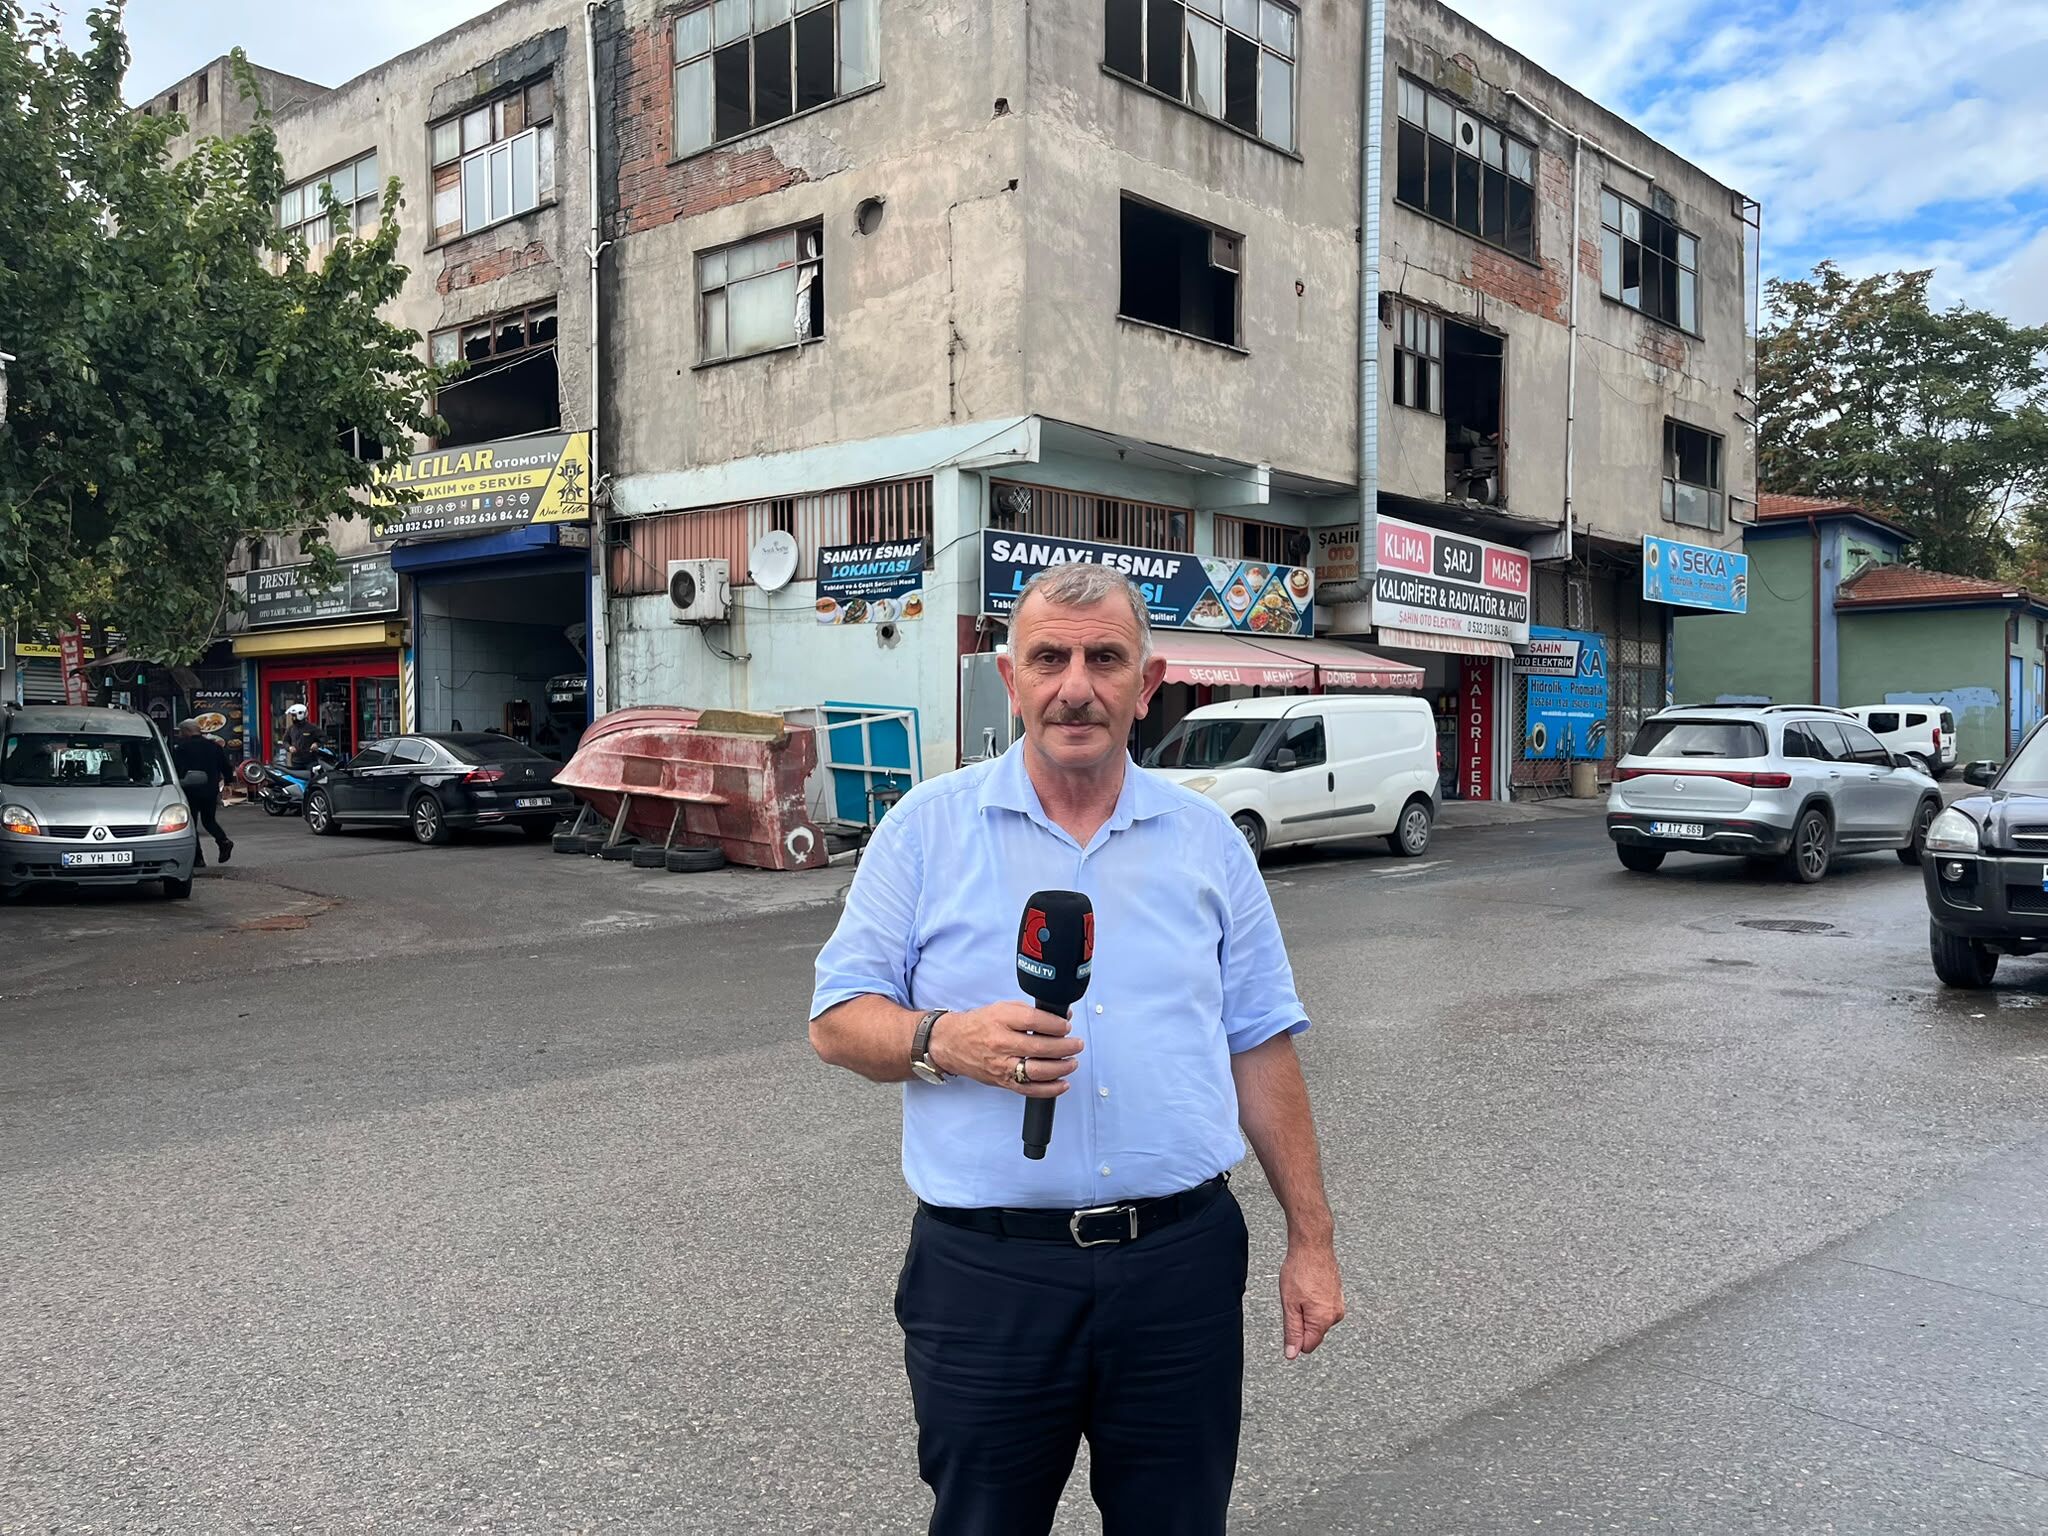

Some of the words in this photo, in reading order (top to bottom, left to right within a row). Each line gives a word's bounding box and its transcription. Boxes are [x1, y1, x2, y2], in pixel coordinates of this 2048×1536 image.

[494, 452, 560, 469] OTOMOTİV
[461, 482, 475, 492] ve
[479, 474, 532, 489] SERVİS
[405, 521, 421, 532] 032
[422, 519, 433, 530] 43
[434, 518, 445, 529] 01
[453, 513, 477, 526] 0532
[479, 512, 497, 523] 636
[500, 510, 515, 521] 84
[516, 508, 529, 520] 42
[875, 543, 921, 559] ESNAF
[1328, 546, 1355, 561] OTO
[1443, 546, 1473, 574] ŞARJ
[832, 560, 911, 578] LOKANTASI
[1101, 552, 1181, 579] ESNAF
[1491, 557, 1522, 587] MARŞ
[1682, 549, 1728, 578] SEKA
[1379, 578, 1437, 607] KALORİFER
[1439, 592, 1446, 607] &
[1449, 591, 1497, 616] RADYATÖR
[1498, 602, 1506, 617] &
[1508, 599, 1526, 620] AKÜ
[1149, 613, 1176, 622] eşitleri
[1420, 613, 1432, 626] OTO
[1472, 621, 1482, 633] 532
[1483, 623, 1494, 635] 313
[1494, 624, 1501, 636] 84
[1501, 625, 1509, 637] 50
[1514, 657, 1530, 667] OTO
[1531, 656, 1573, 668] ELEKTRİK
[1578, 648, 1605, 679] KA
[1189, 668, 1241, 683] SEÇMELİ
[1262, 669, 1294, 683] MENÜ
[1388, 673, 1419, 685] IZGARA
[1470, 669, 1482, 797] KALORİFER
[1667, 823, 1682, 833] ATZ
[1686, 825, 1702, 834] 669
[69, 854, 83, 864] 28
[90, 853, 104, 862] YH
[111, 853, 131, 862] 103
[1042, 968, 1053, 977] TV
